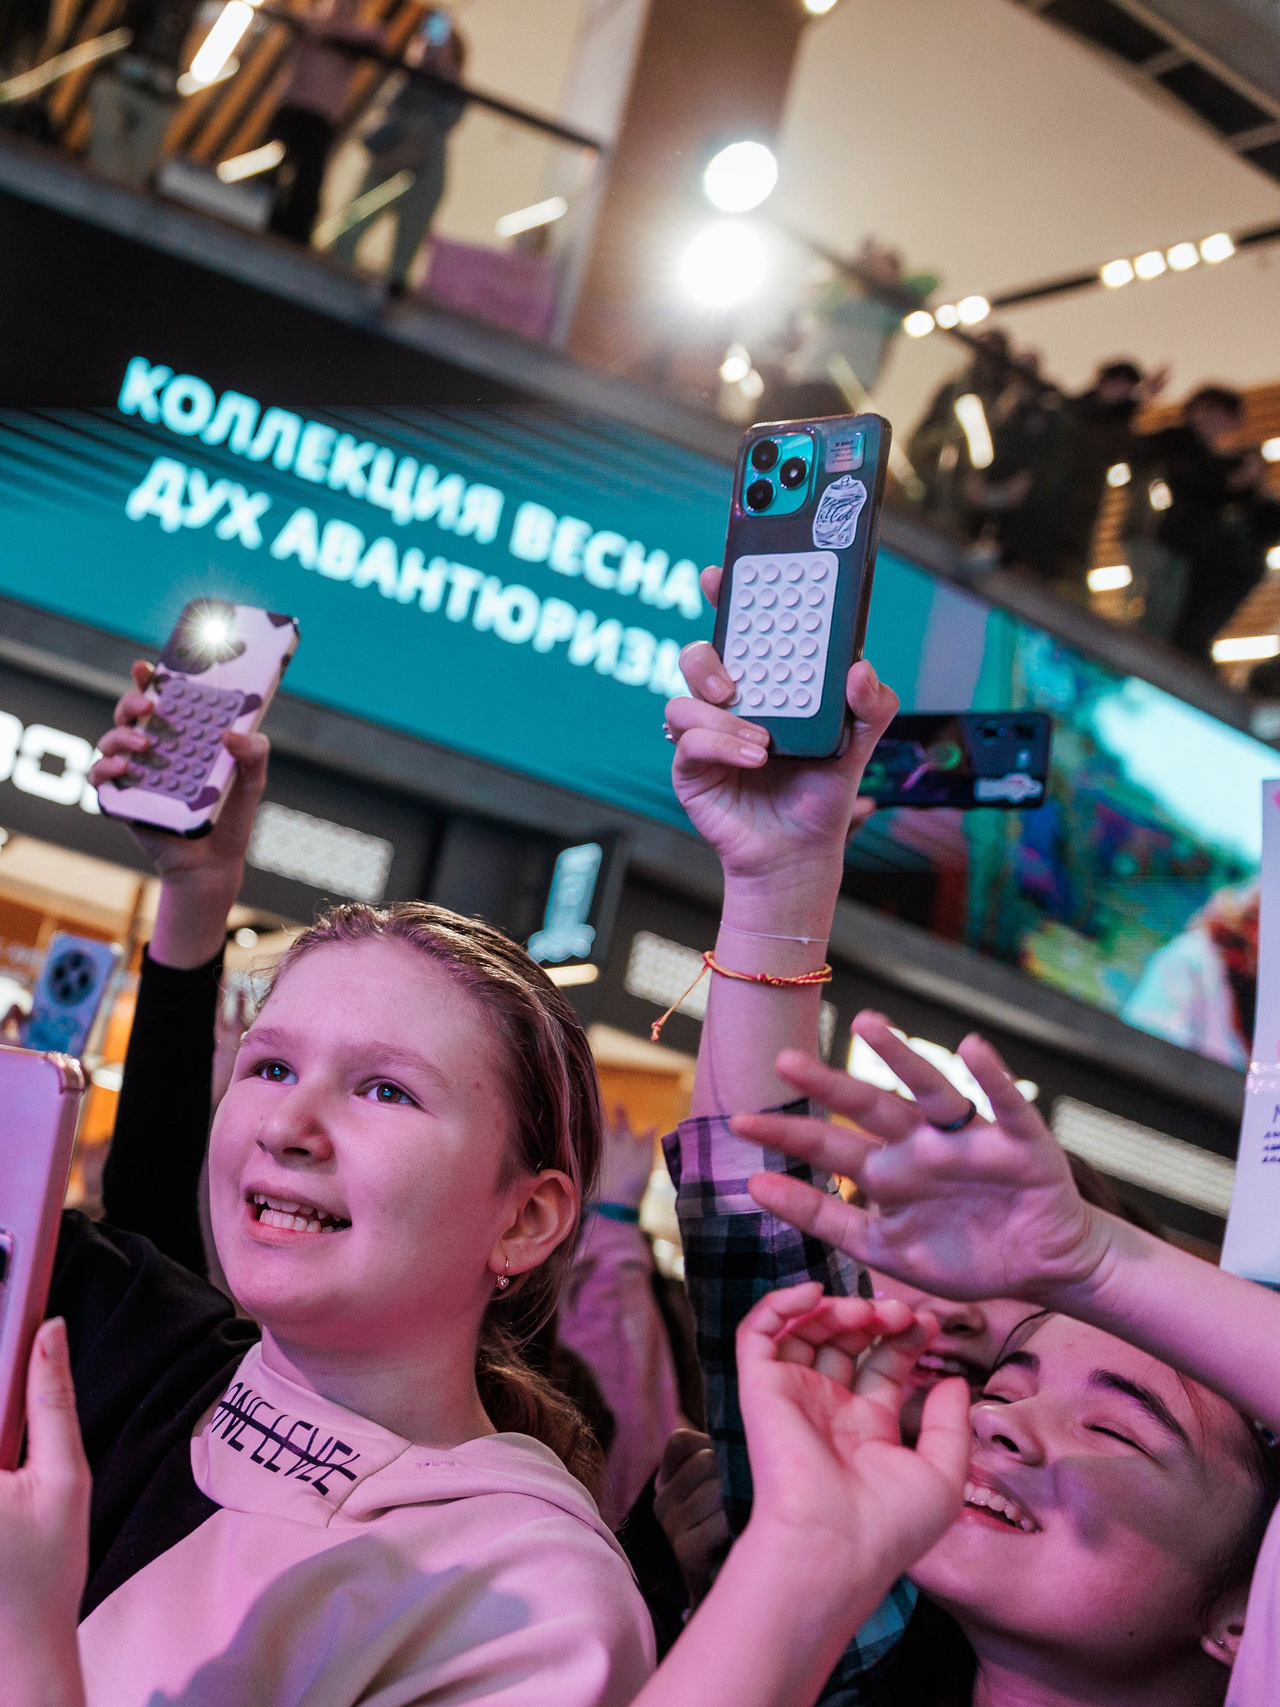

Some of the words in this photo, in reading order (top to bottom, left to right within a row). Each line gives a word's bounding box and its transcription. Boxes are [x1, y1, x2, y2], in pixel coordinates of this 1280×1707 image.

[118, 356, 504, 544] КОЛЛЕКЦИЯ
[510, 501, 702, 619] ВЕСНА
[125, 456, 271, 549] ДУХ
